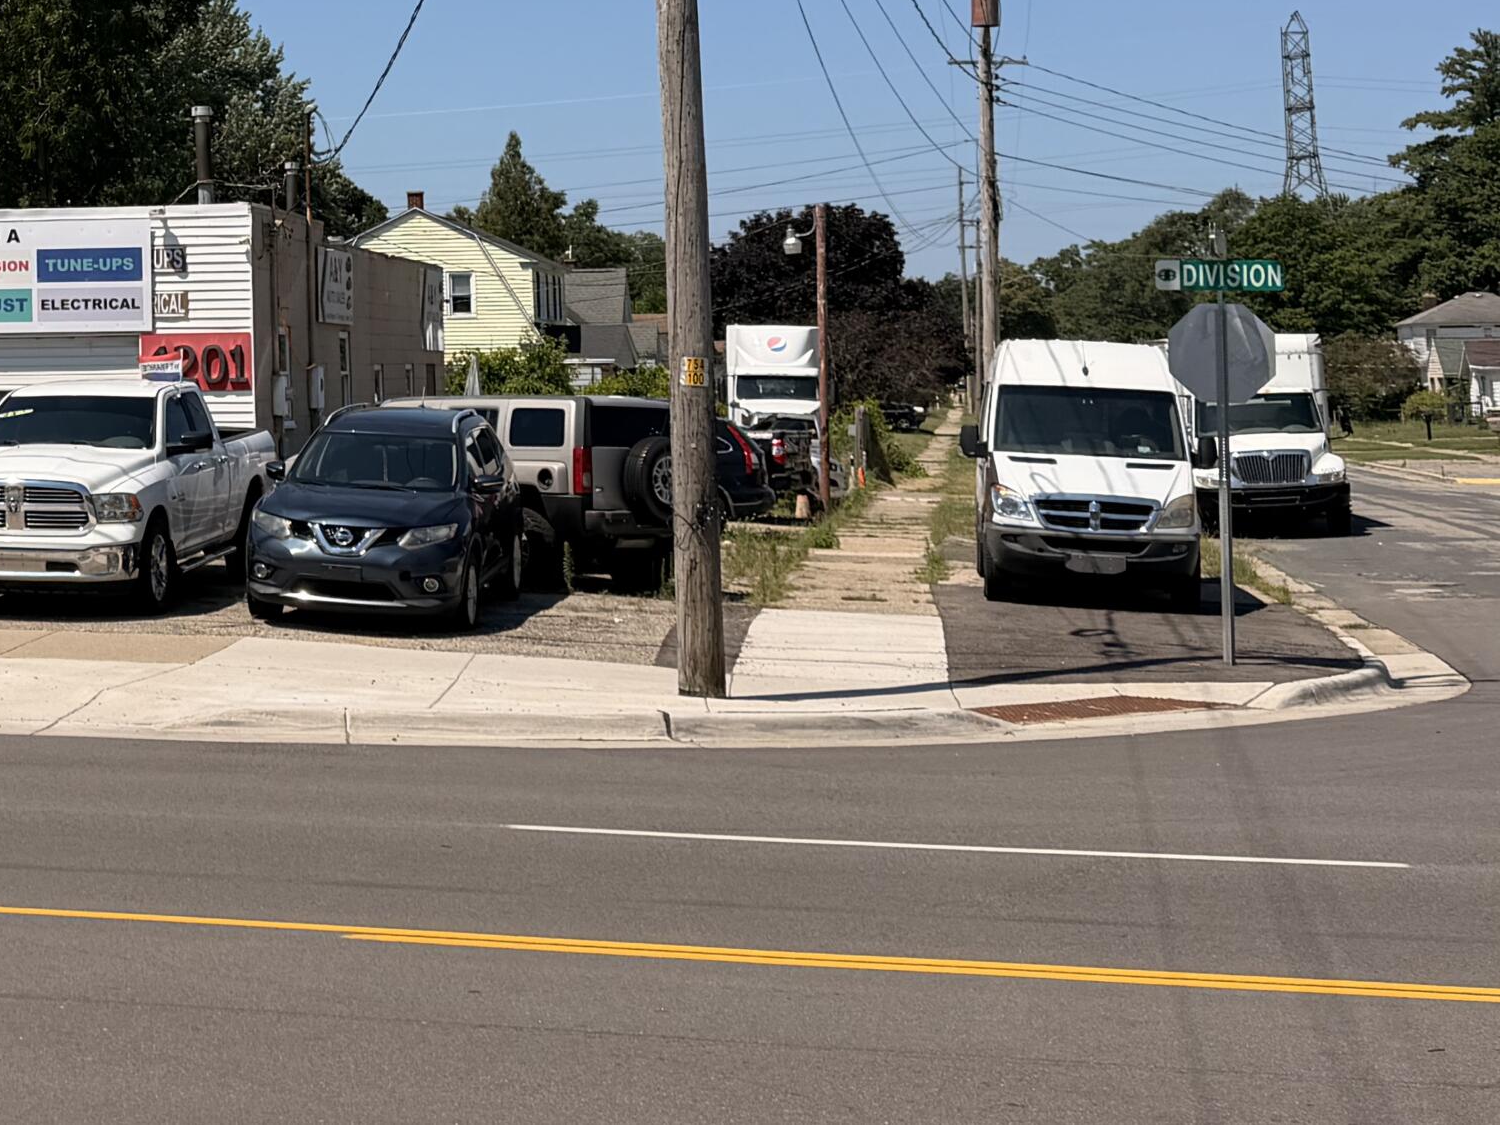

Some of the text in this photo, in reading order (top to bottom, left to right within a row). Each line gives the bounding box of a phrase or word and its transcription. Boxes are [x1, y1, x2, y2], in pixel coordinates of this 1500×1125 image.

[7, 228, 20, 243] A
[45, 257, 134, 272] TUNE-UPS
[1182, 264, 1283, 287] DIVISION
[41, 296, 141, 311] ELECTRICAL
[688, 373, 705, 385] 100
